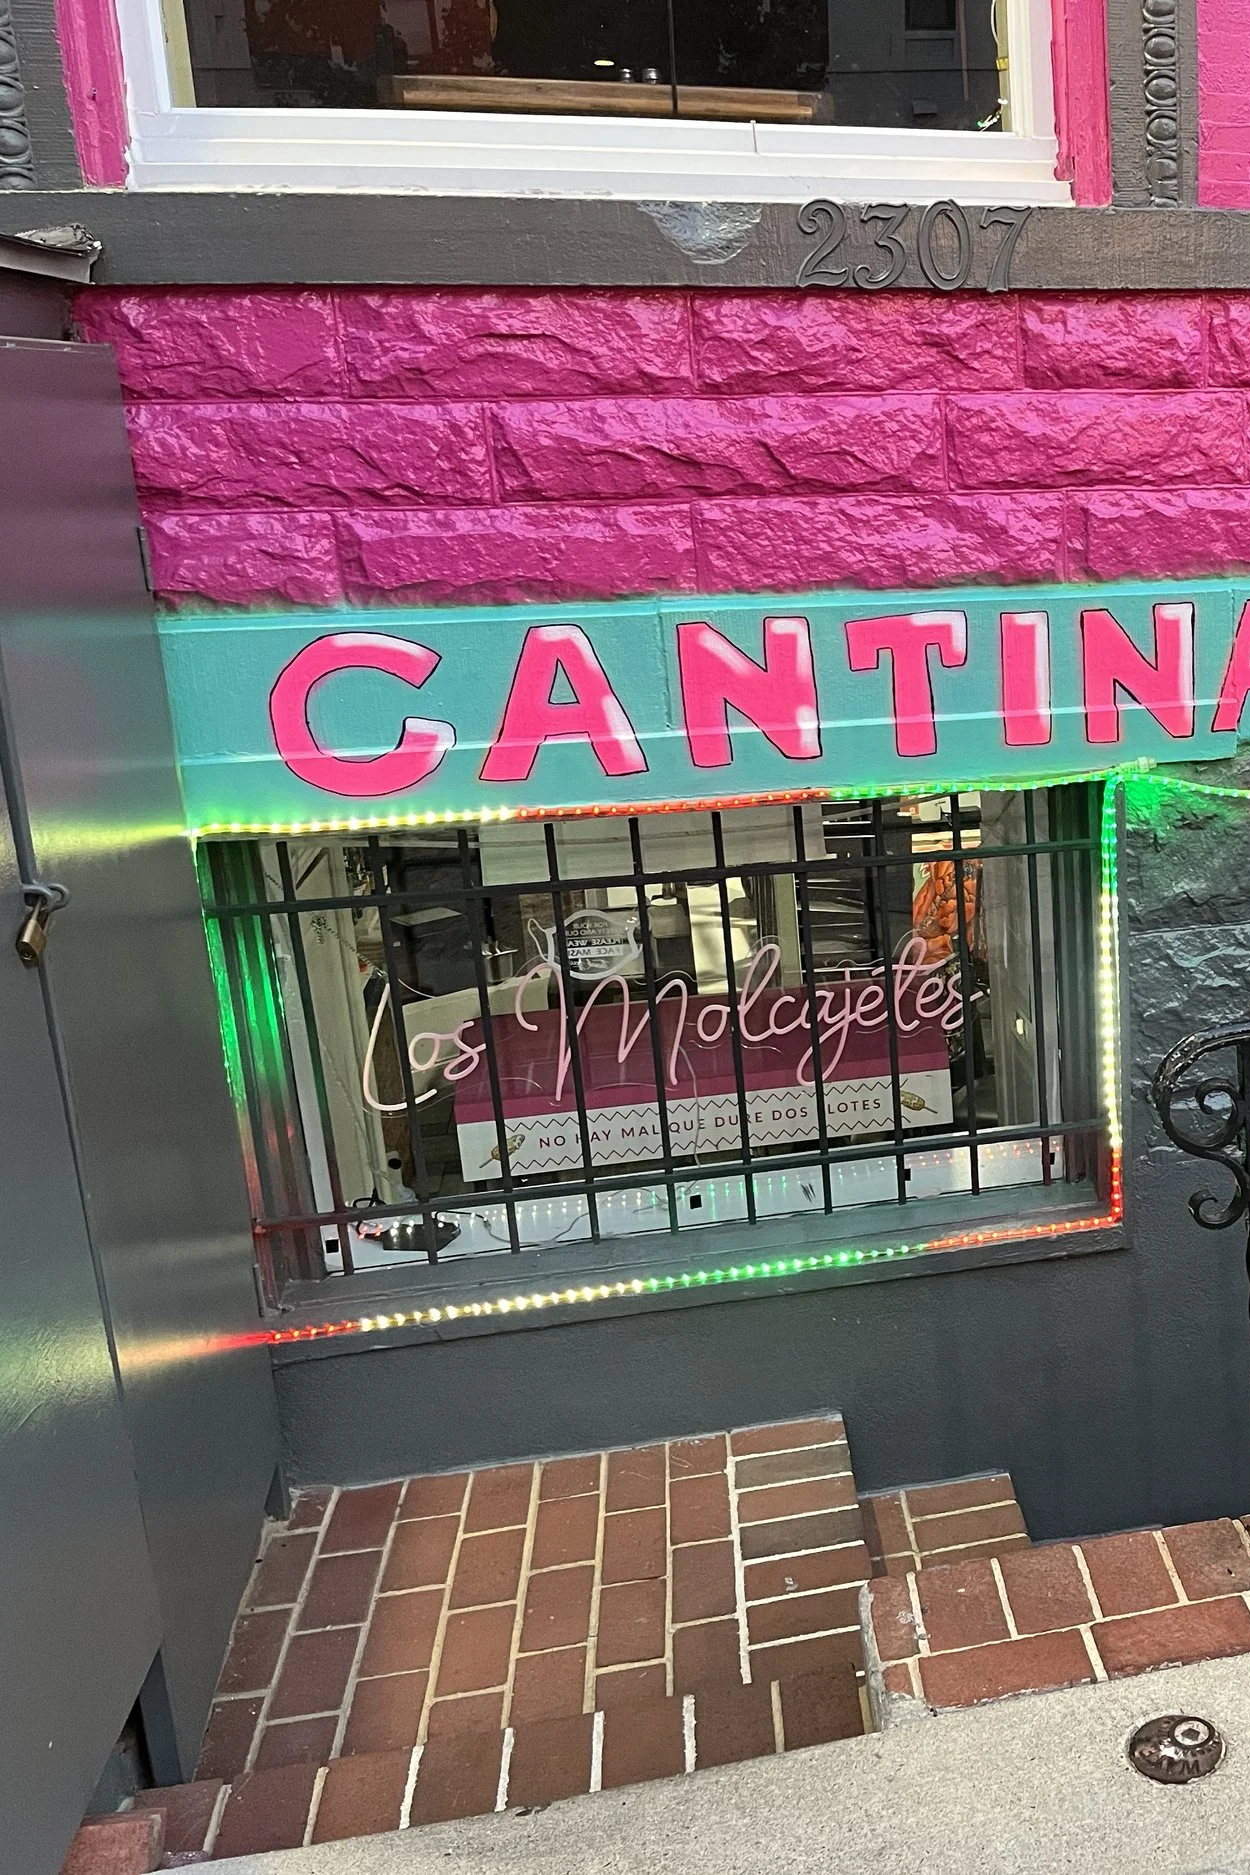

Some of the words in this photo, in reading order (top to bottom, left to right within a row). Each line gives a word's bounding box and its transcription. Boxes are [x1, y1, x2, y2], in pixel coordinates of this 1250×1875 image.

[796, 198, 1033, 292] 2307
[364, 982, 488, 1112] Los
[515, 936, 983, 1102] Molcajetes
[539, 1135, 566, 1149] NO
[620, 1124, 660, 1139] MAL
[668, 1118, 707, 1134] QUE
[772, 1106, 809, 1121] DOS
[827, 1098, 881, 1115] LOTES
